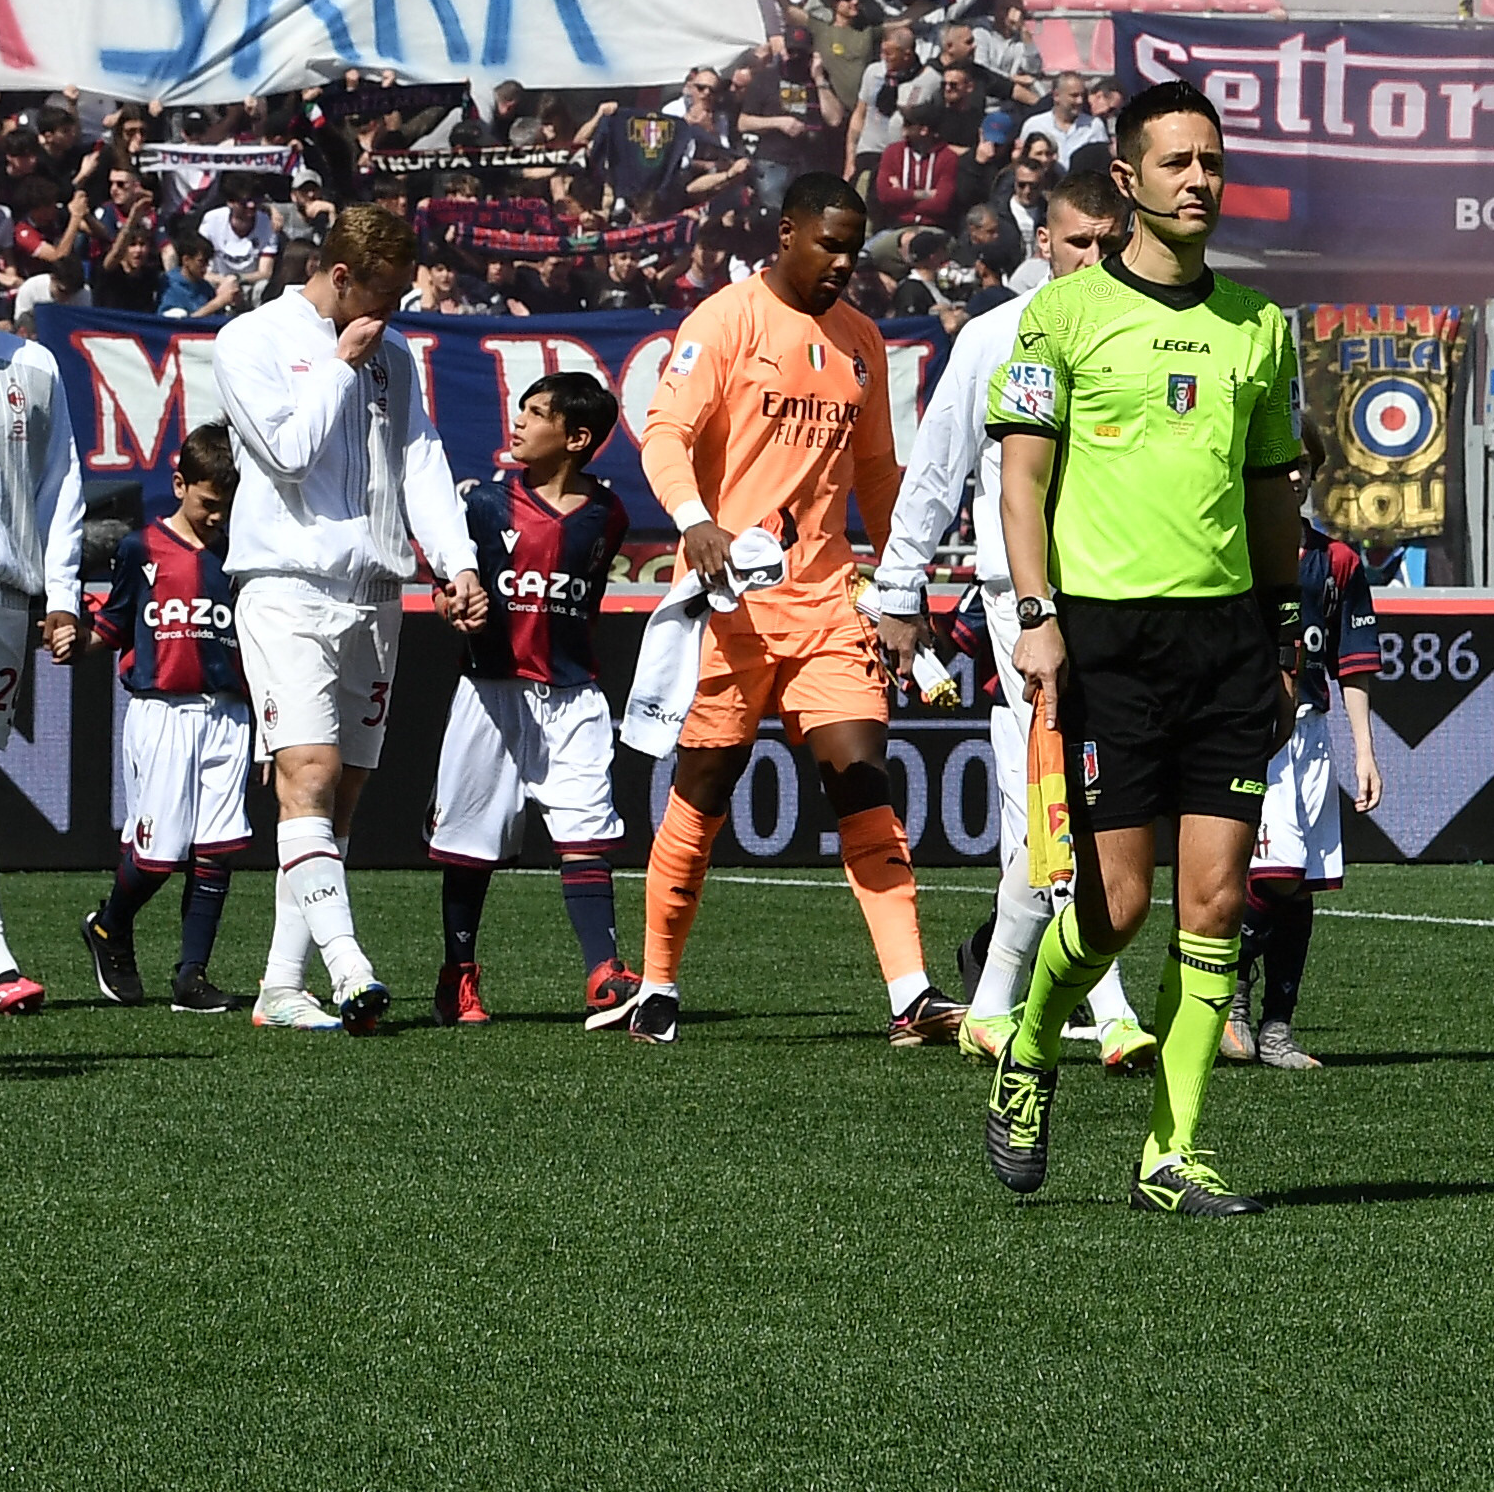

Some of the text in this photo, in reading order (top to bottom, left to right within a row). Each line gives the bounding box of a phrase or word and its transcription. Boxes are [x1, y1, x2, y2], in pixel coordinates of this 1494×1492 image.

[1152, 338, 1213, 355] LEGEA
[1338, 337, 1445, 374] FILA
[760, 389, 860, 425] Emirate
[774, 424, 804, 447] FLY
[497, 568, 584, 600] CAZO
[143, 598, 232, 629] CAZO
[154, 629, 183, 645] Cerca.
[302, 885, 339, 907] ACM
